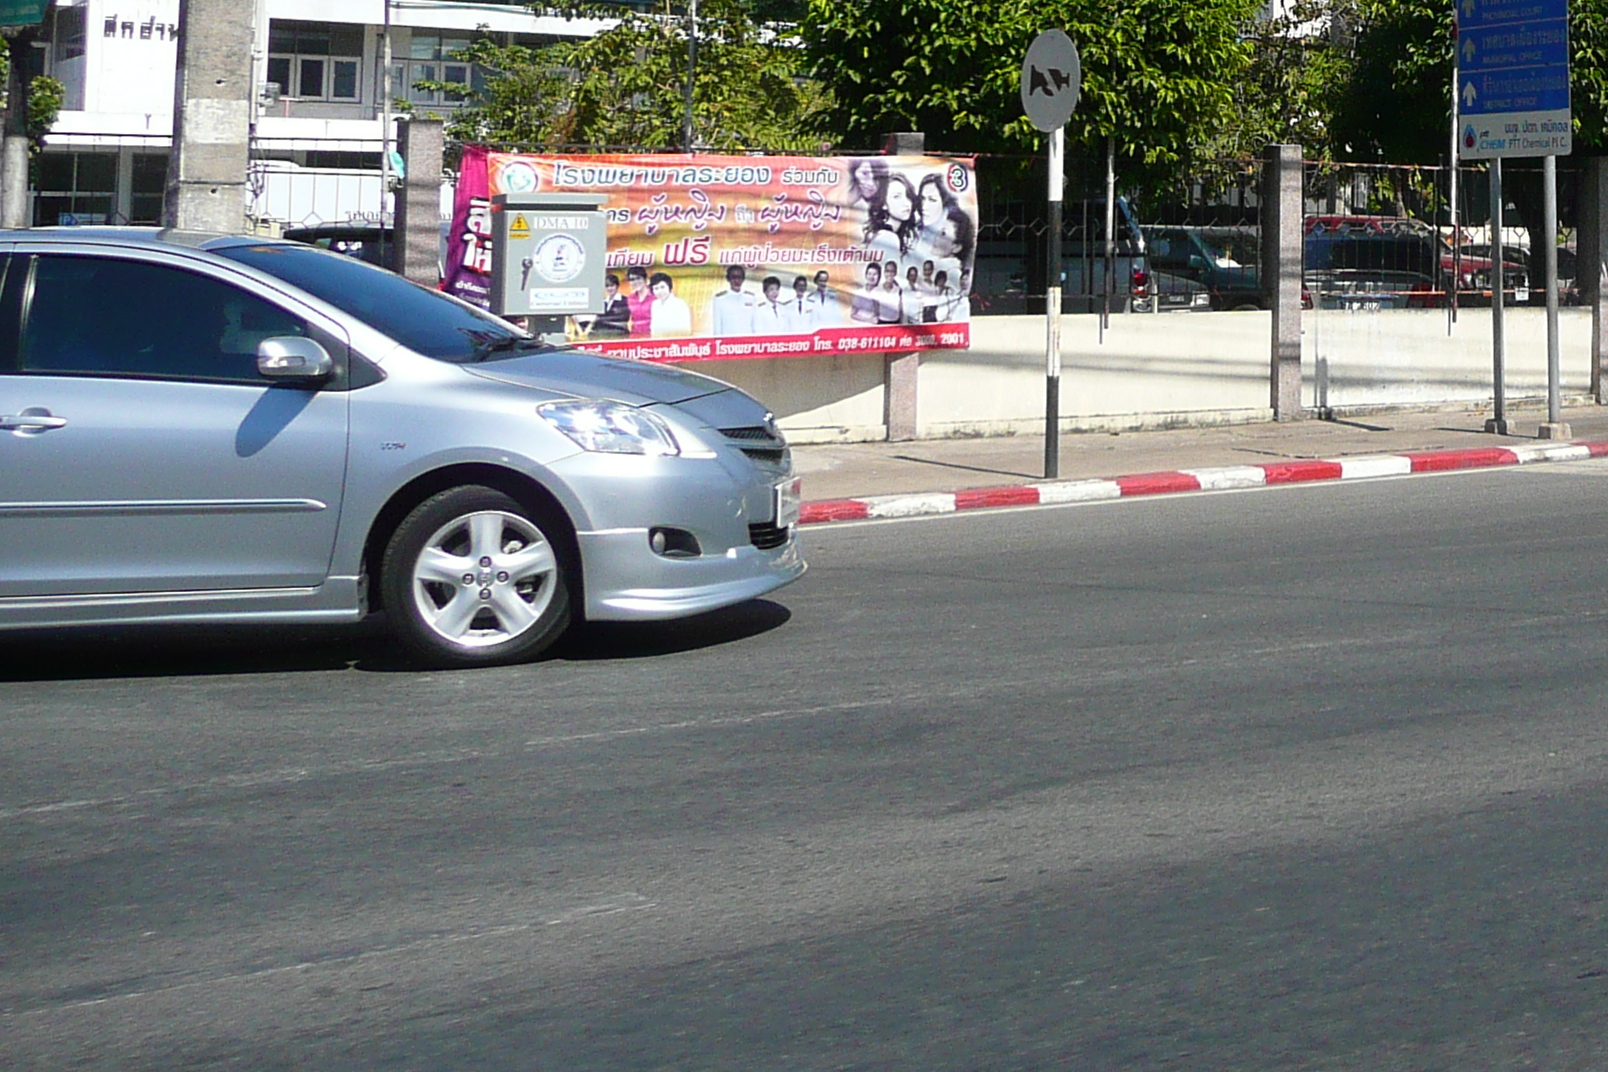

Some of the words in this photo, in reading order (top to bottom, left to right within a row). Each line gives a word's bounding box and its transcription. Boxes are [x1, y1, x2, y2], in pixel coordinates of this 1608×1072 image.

[554, 163, 770, 186] โรงพยาบาลระยอง
[782, 169, 839, 185] ร่วมกับ
[637, 191, 726, 233] ผู้หญิง
[760, 192, 842, 232] ผู้หญิง
[662, 235, 712, 265] ฟรี
[715, 340, 810, 355] โรงพยาบาลระยอง
